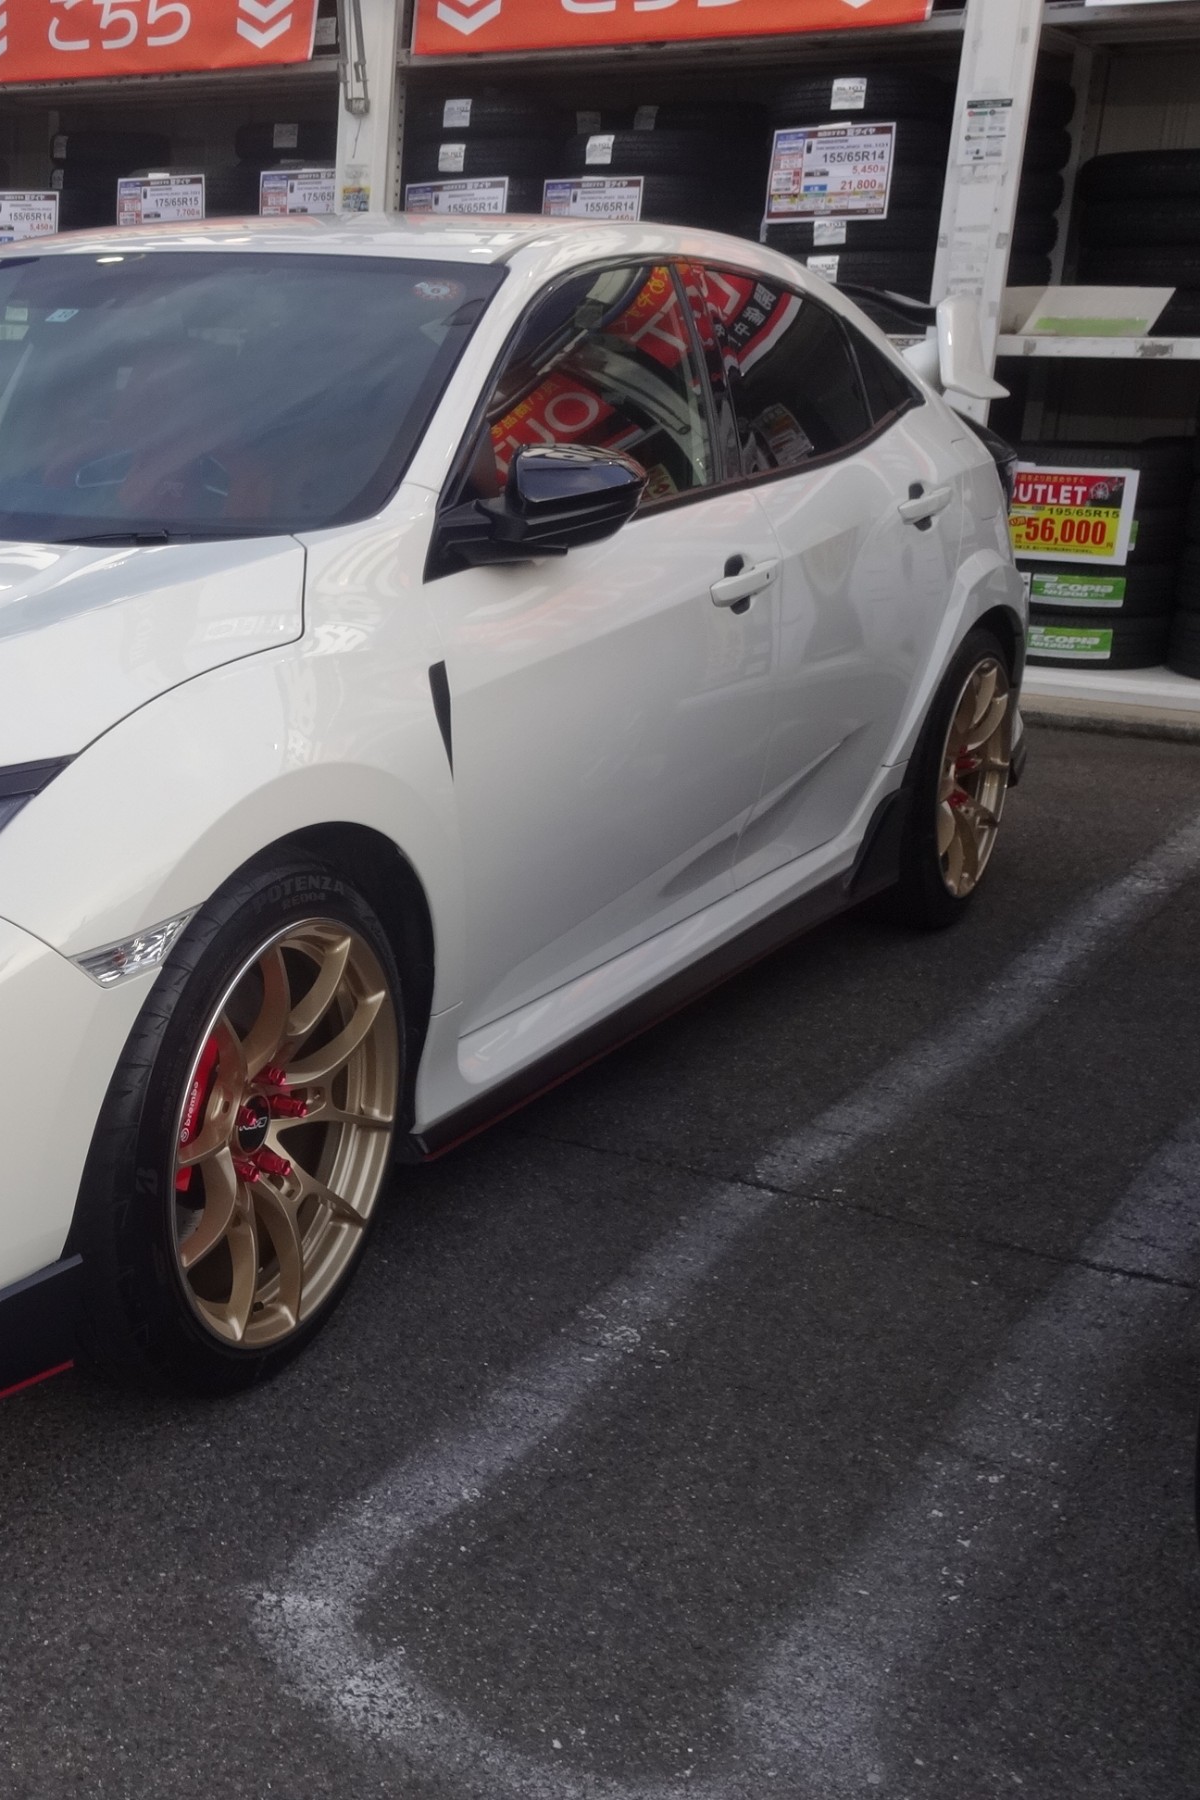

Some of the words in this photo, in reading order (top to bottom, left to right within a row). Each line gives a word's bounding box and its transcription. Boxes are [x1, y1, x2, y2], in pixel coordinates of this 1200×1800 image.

[822, 151, 885, 164] 155/65R14
[154, 199, 200, 208] 175/65R15
[585, 202, 635, 213] 155/65R14
[8, 212, 53, 222] 155/65R14
[1048, 507, 1120, 519] 195/65R15
[1044, 582, 1114, 593] ECOPIA
[1030, 634, 1101, 645] ECOPIA
[184, 1081, 199, 1127] brembo
